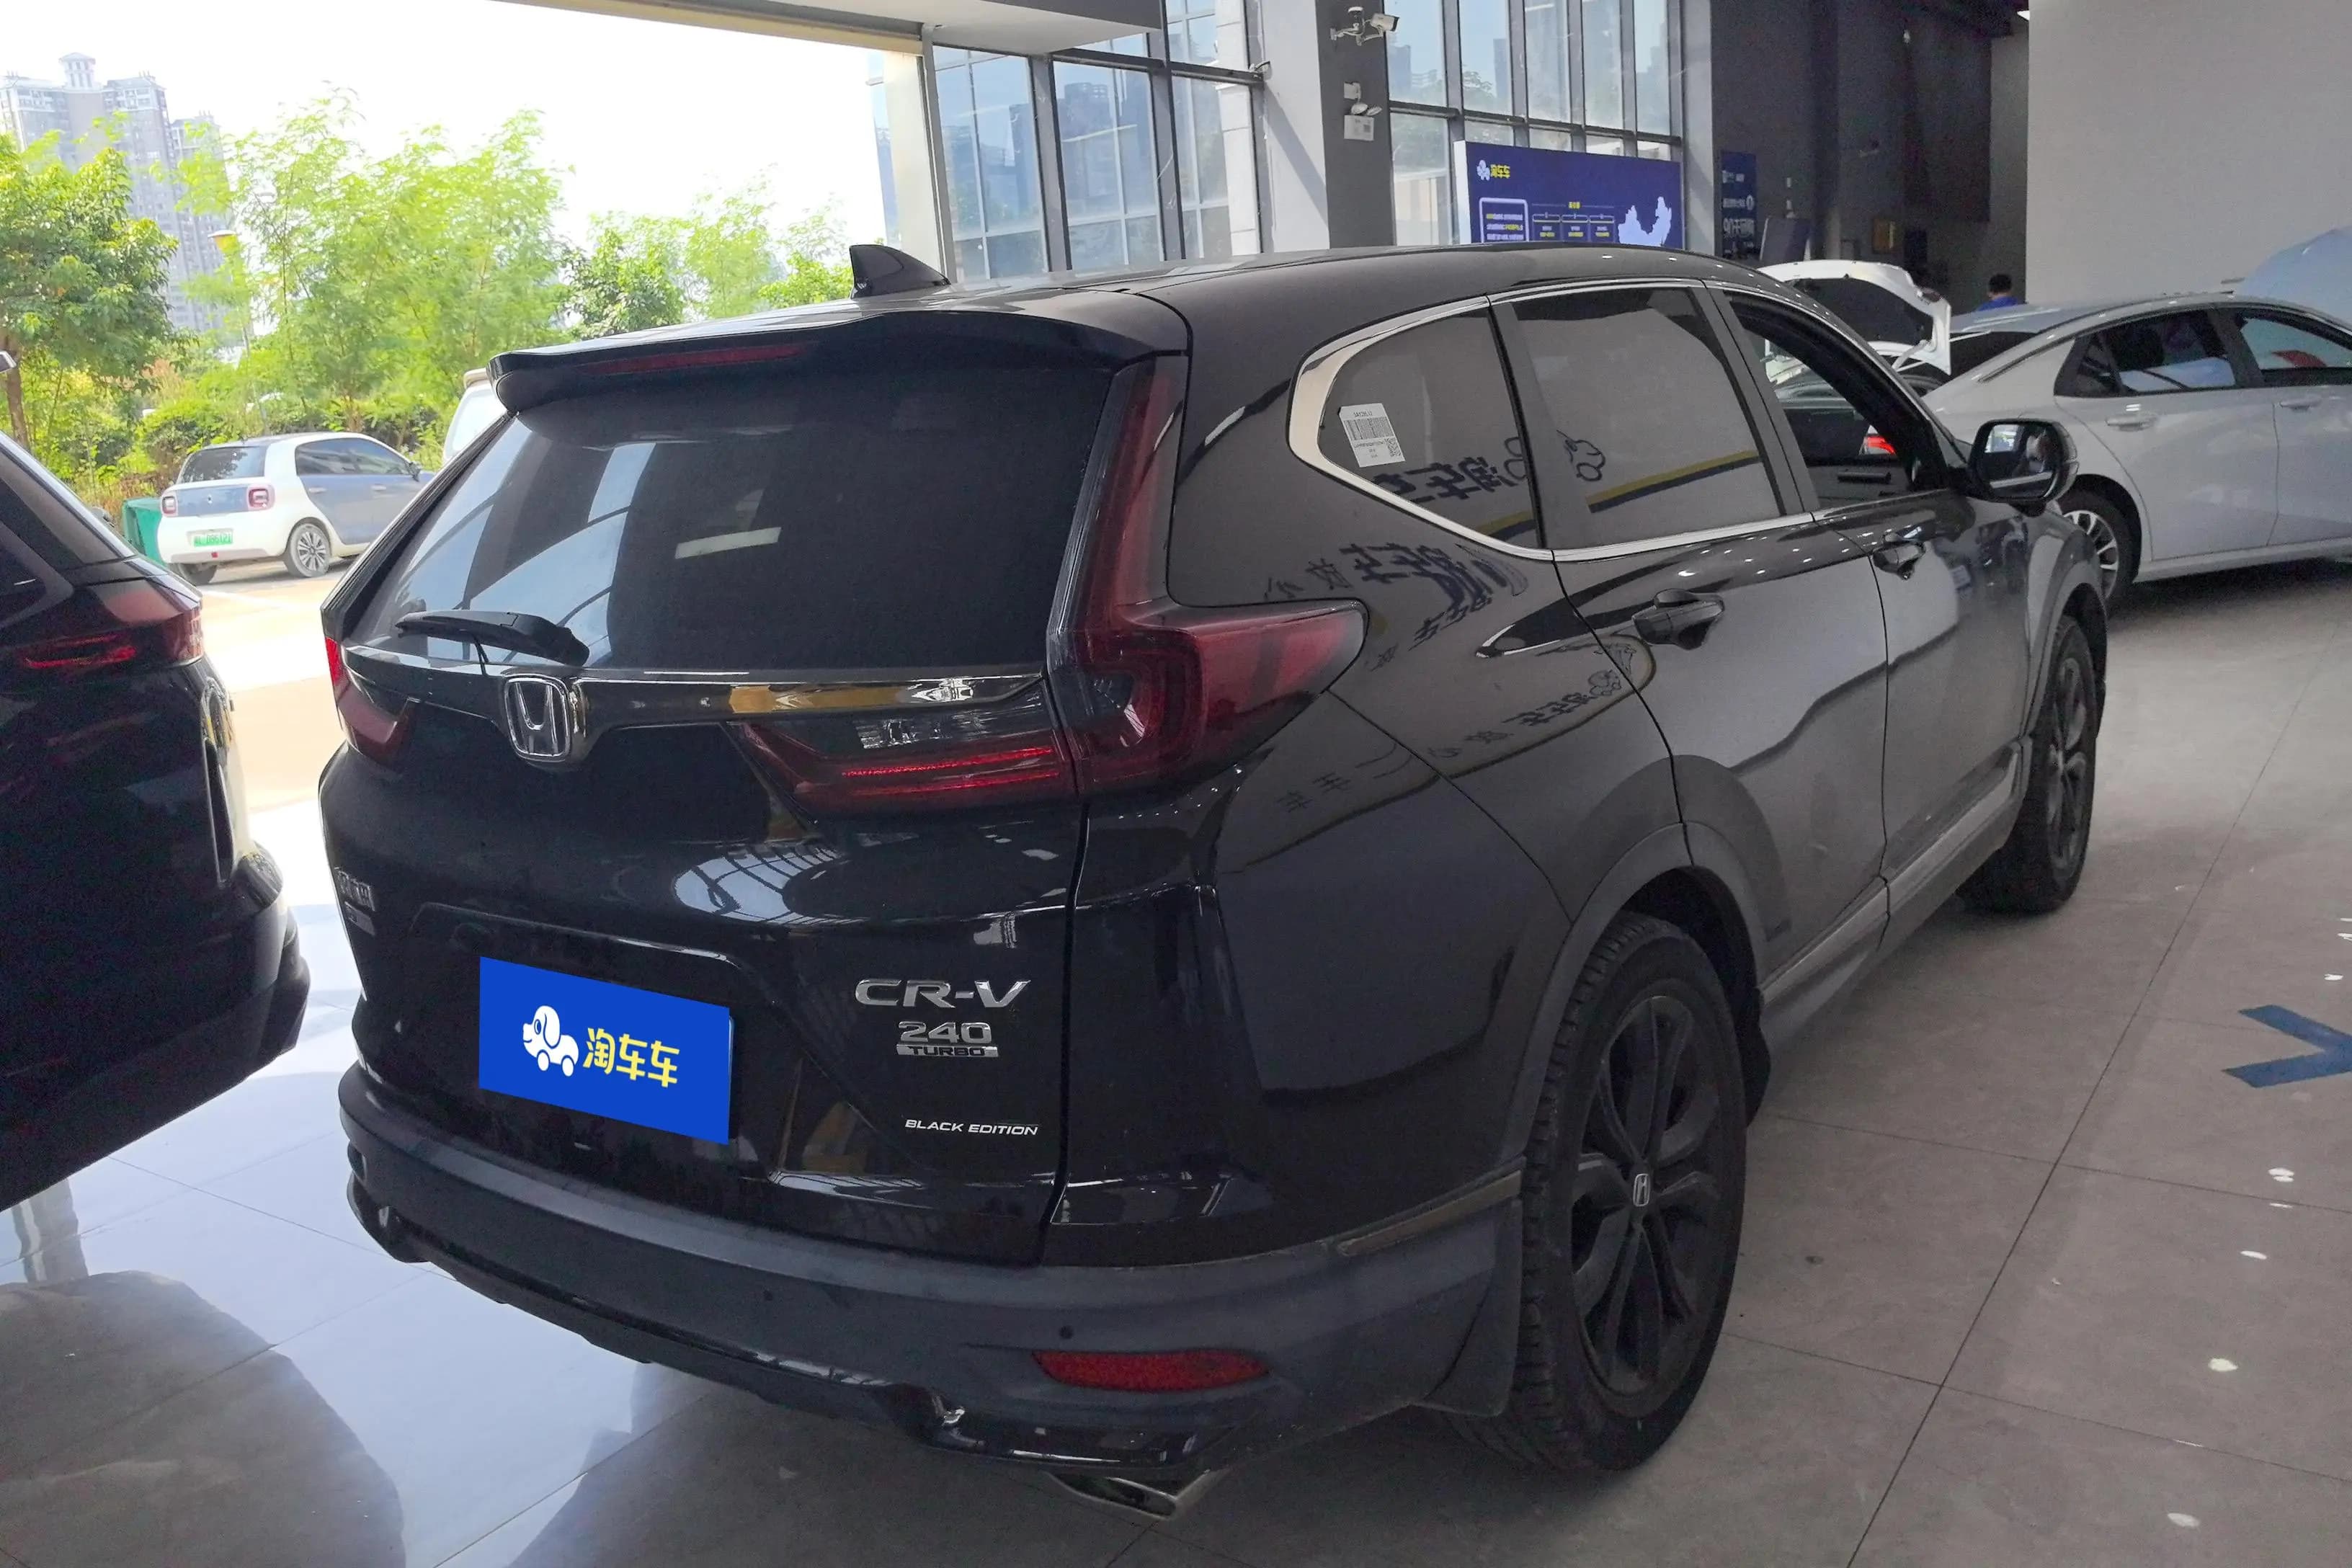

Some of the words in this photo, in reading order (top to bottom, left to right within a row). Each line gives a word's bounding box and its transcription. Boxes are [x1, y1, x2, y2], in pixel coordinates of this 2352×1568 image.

[855, 978, 1032, 1009] CR-V
[898, 1020, 992, 1044] 240
[905, 1045, 986, 1057] TURBO
[904, 1119, 963, 1132] BLACK
[968, 1121, 1038, 1136] EDITION
